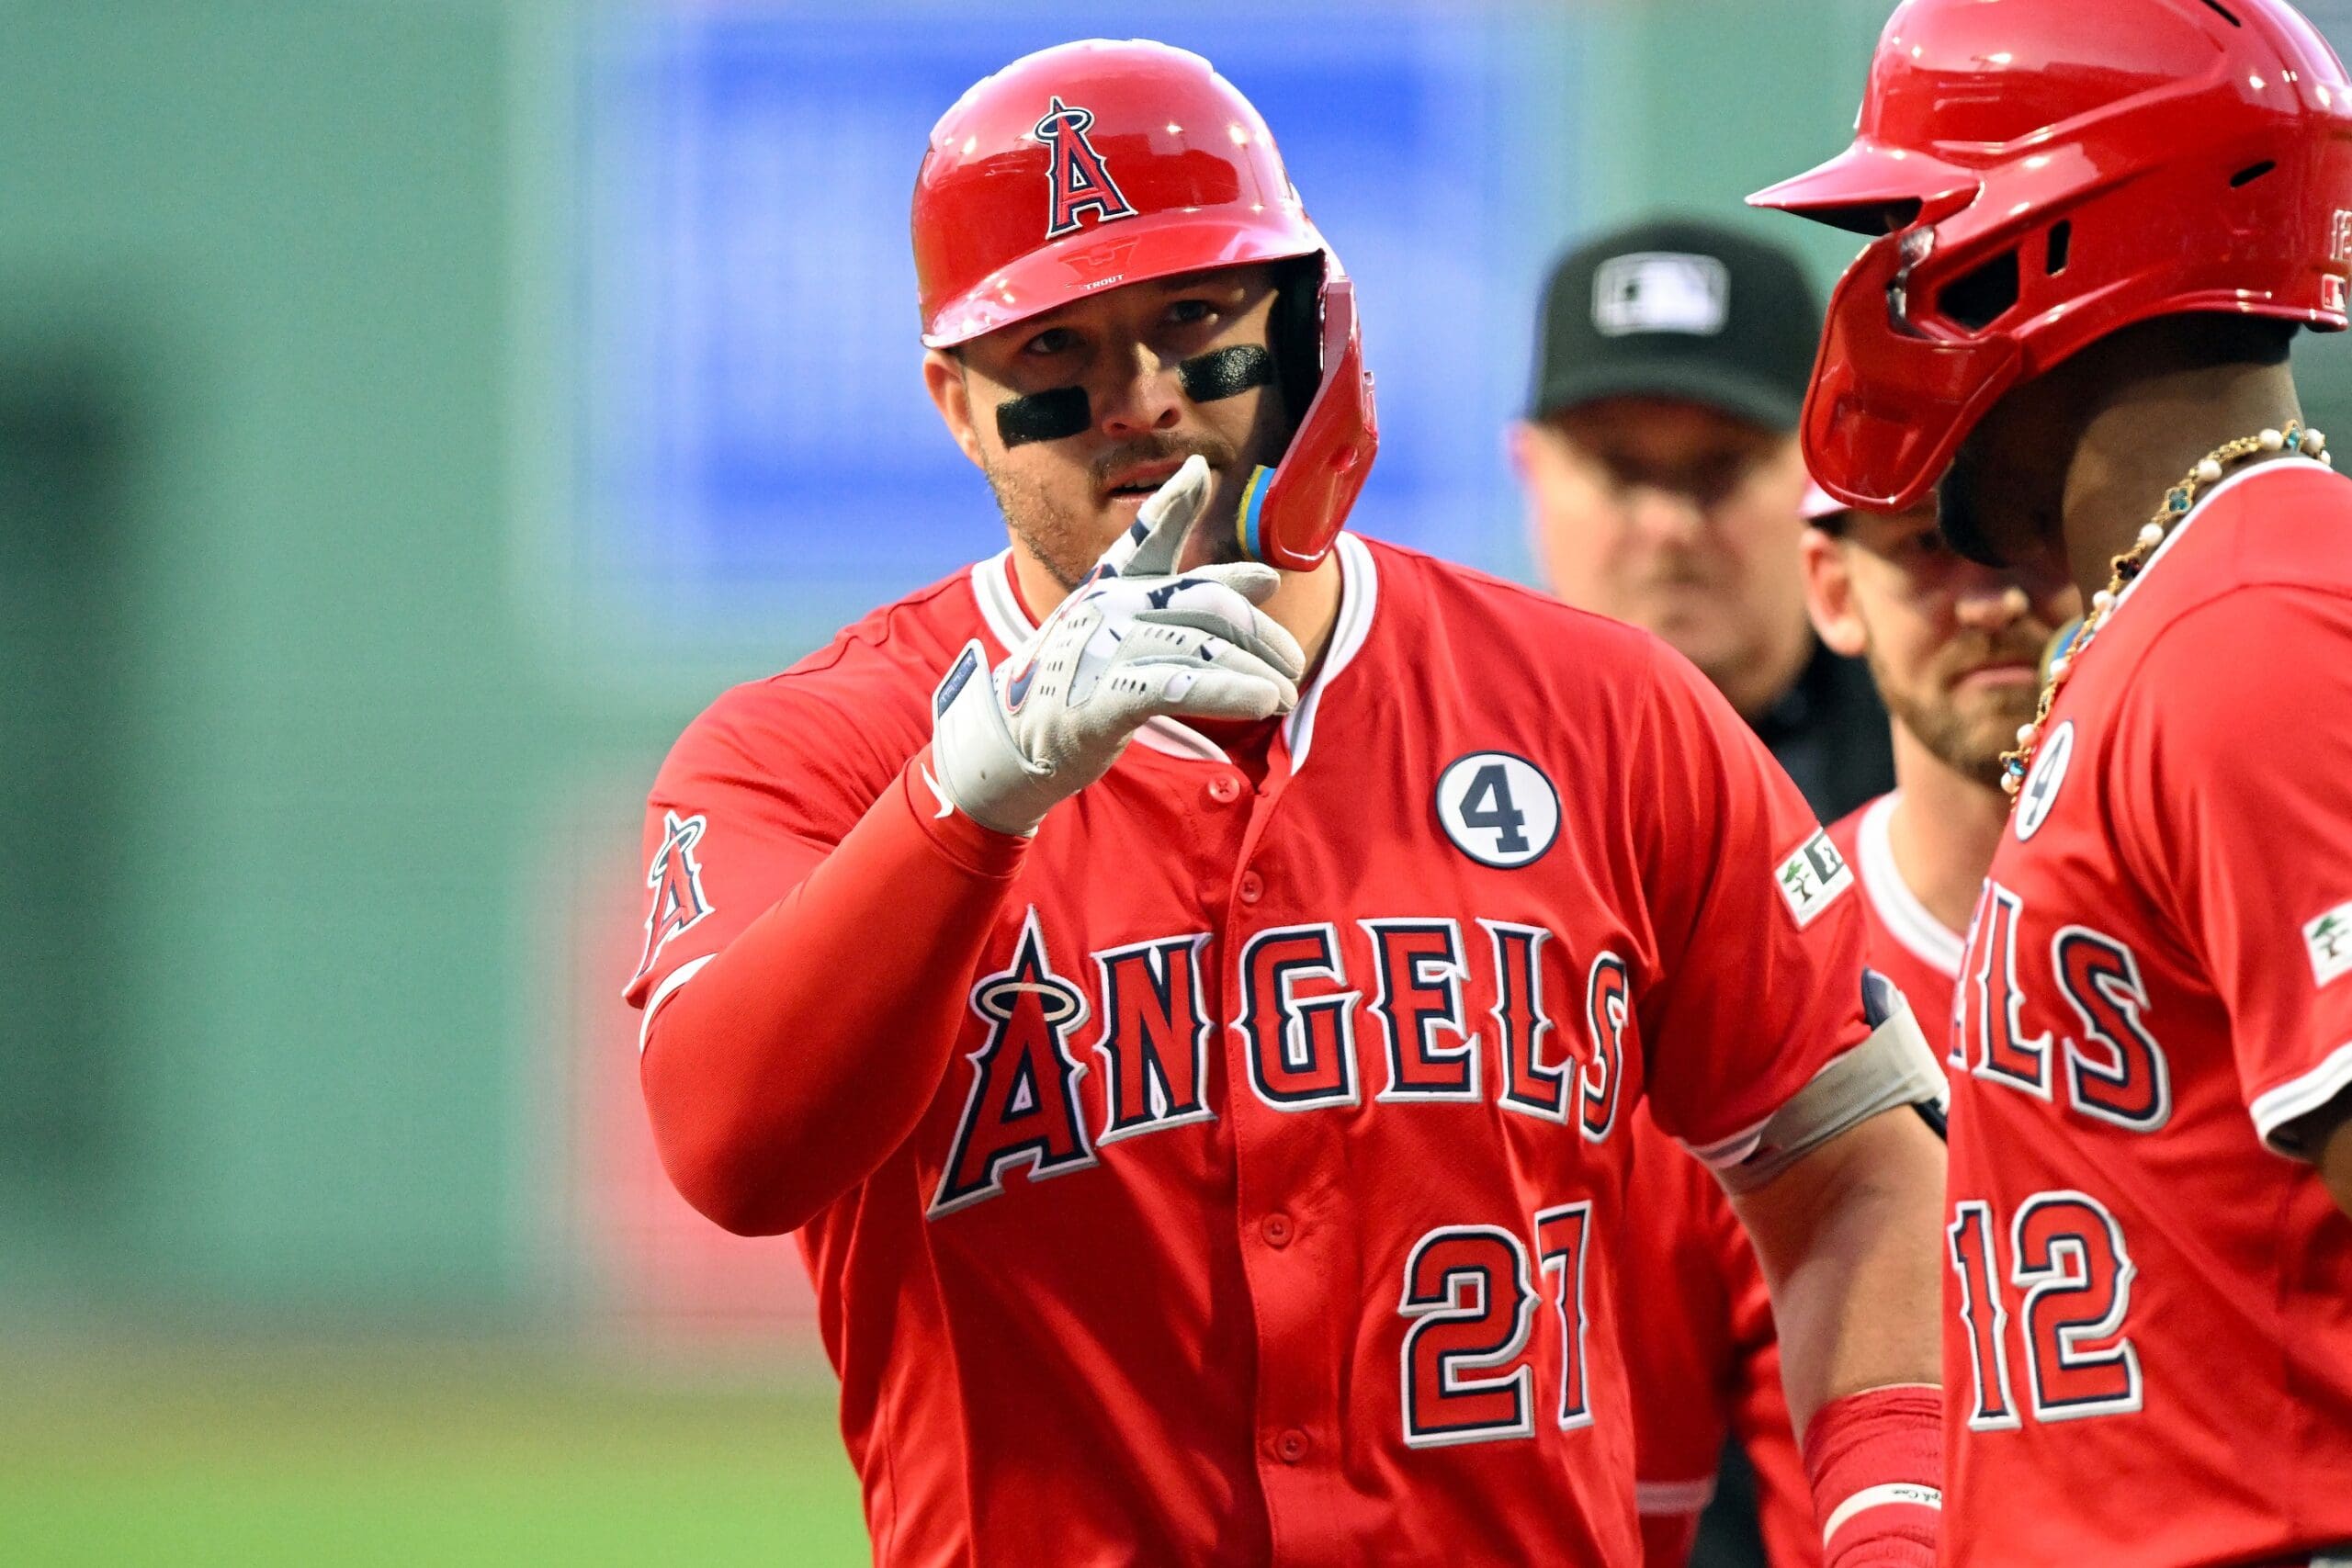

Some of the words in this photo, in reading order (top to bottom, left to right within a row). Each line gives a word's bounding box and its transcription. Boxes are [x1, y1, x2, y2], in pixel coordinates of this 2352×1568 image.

[1084, 273, 1125, 290] TROUT
[1459, 763, 1531, 853] 4
[925, 903, 1631, 1221] ANGELS
[1396, 1199, 1595, 1450] 27
[1947, 1190, 2143, 1431] 12
